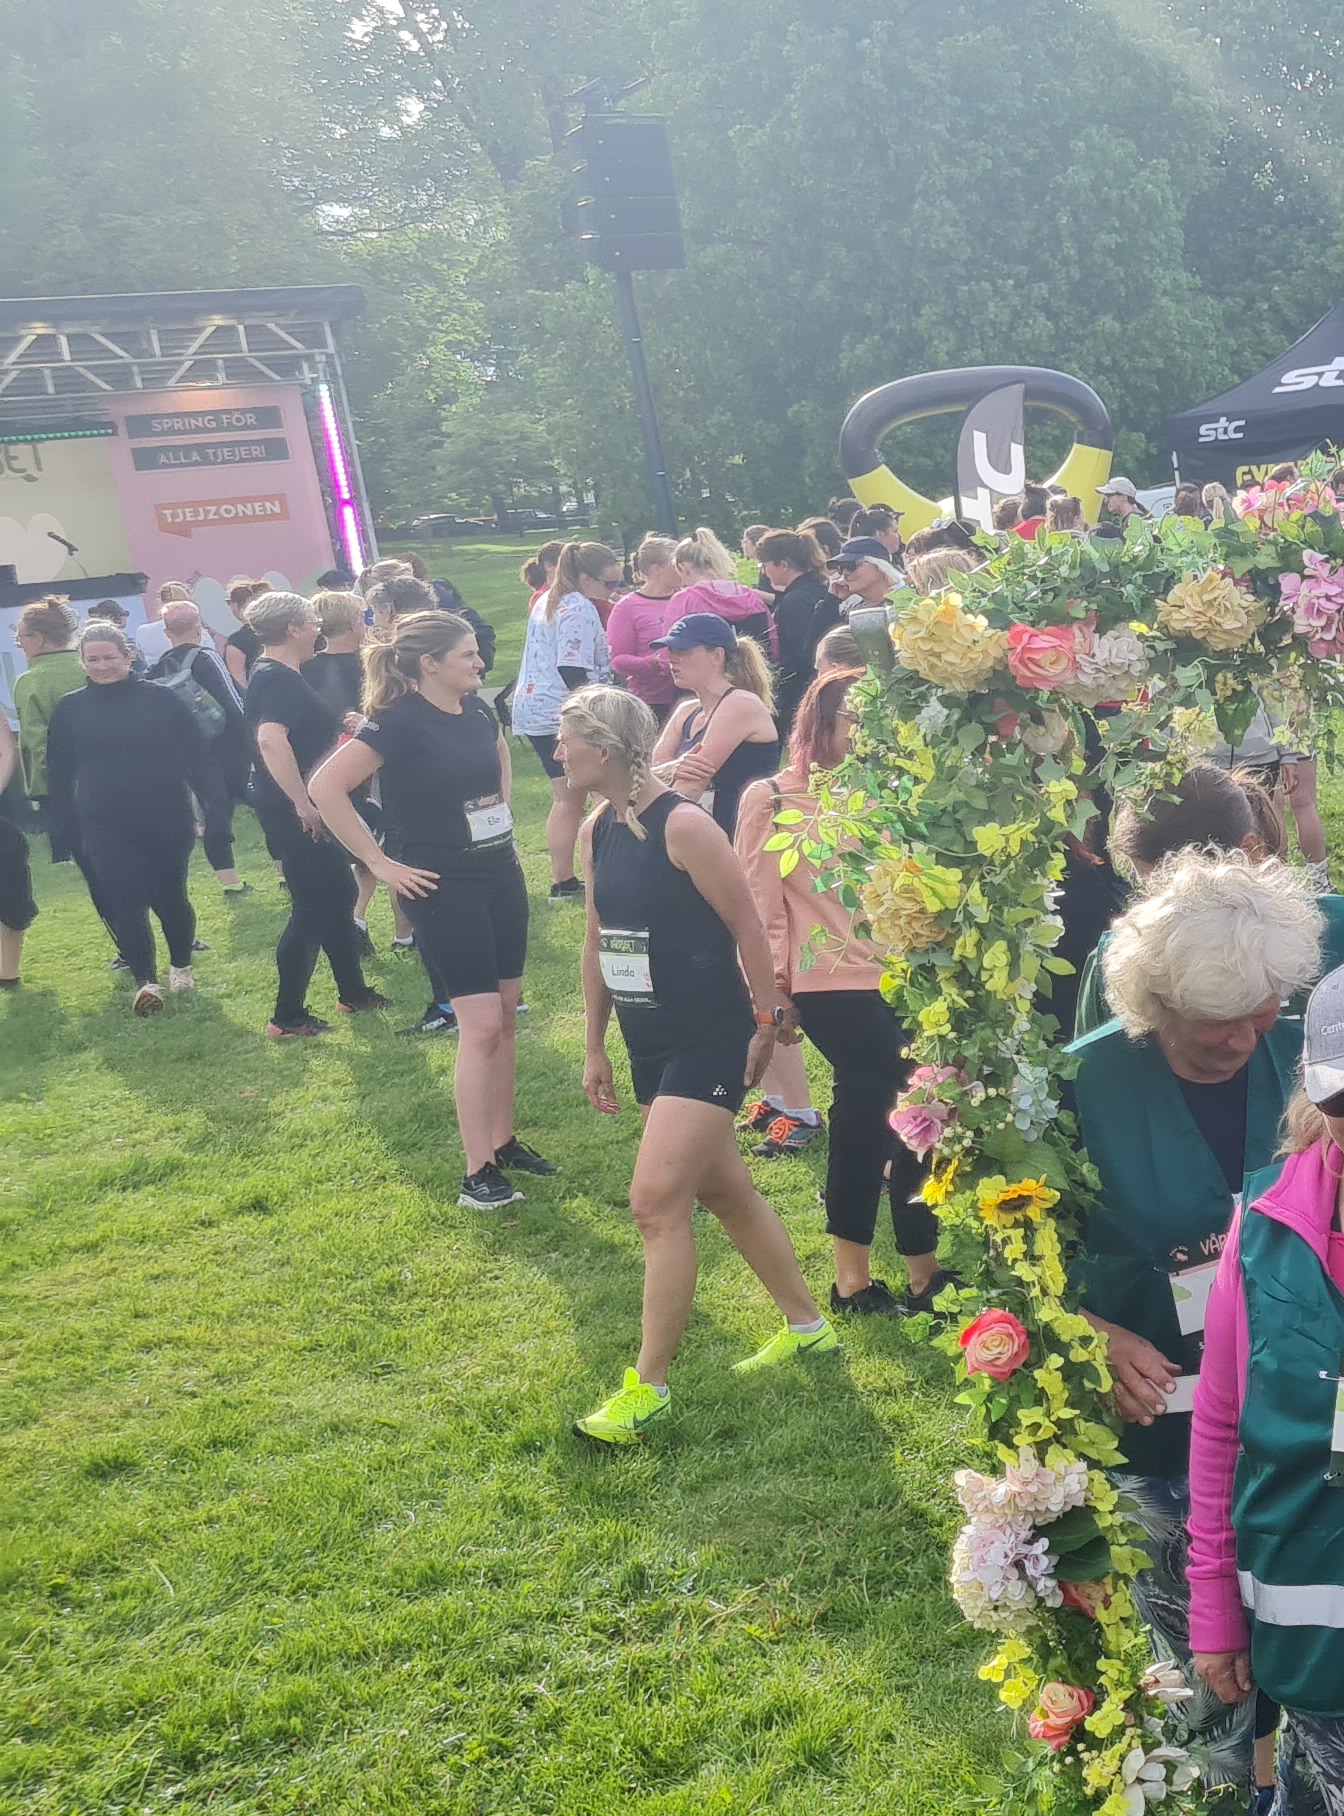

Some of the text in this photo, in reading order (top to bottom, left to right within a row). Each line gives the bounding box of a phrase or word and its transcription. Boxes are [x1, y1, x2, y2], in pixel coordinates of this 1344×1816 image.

[151, 411, 257, 432] SPRING FÖR
[1198, 416, 1246, 442] stc
[158, 445, 266, 465] ALLA TJEJER!
[163, 501, 281, 523] TJEJZONEN
